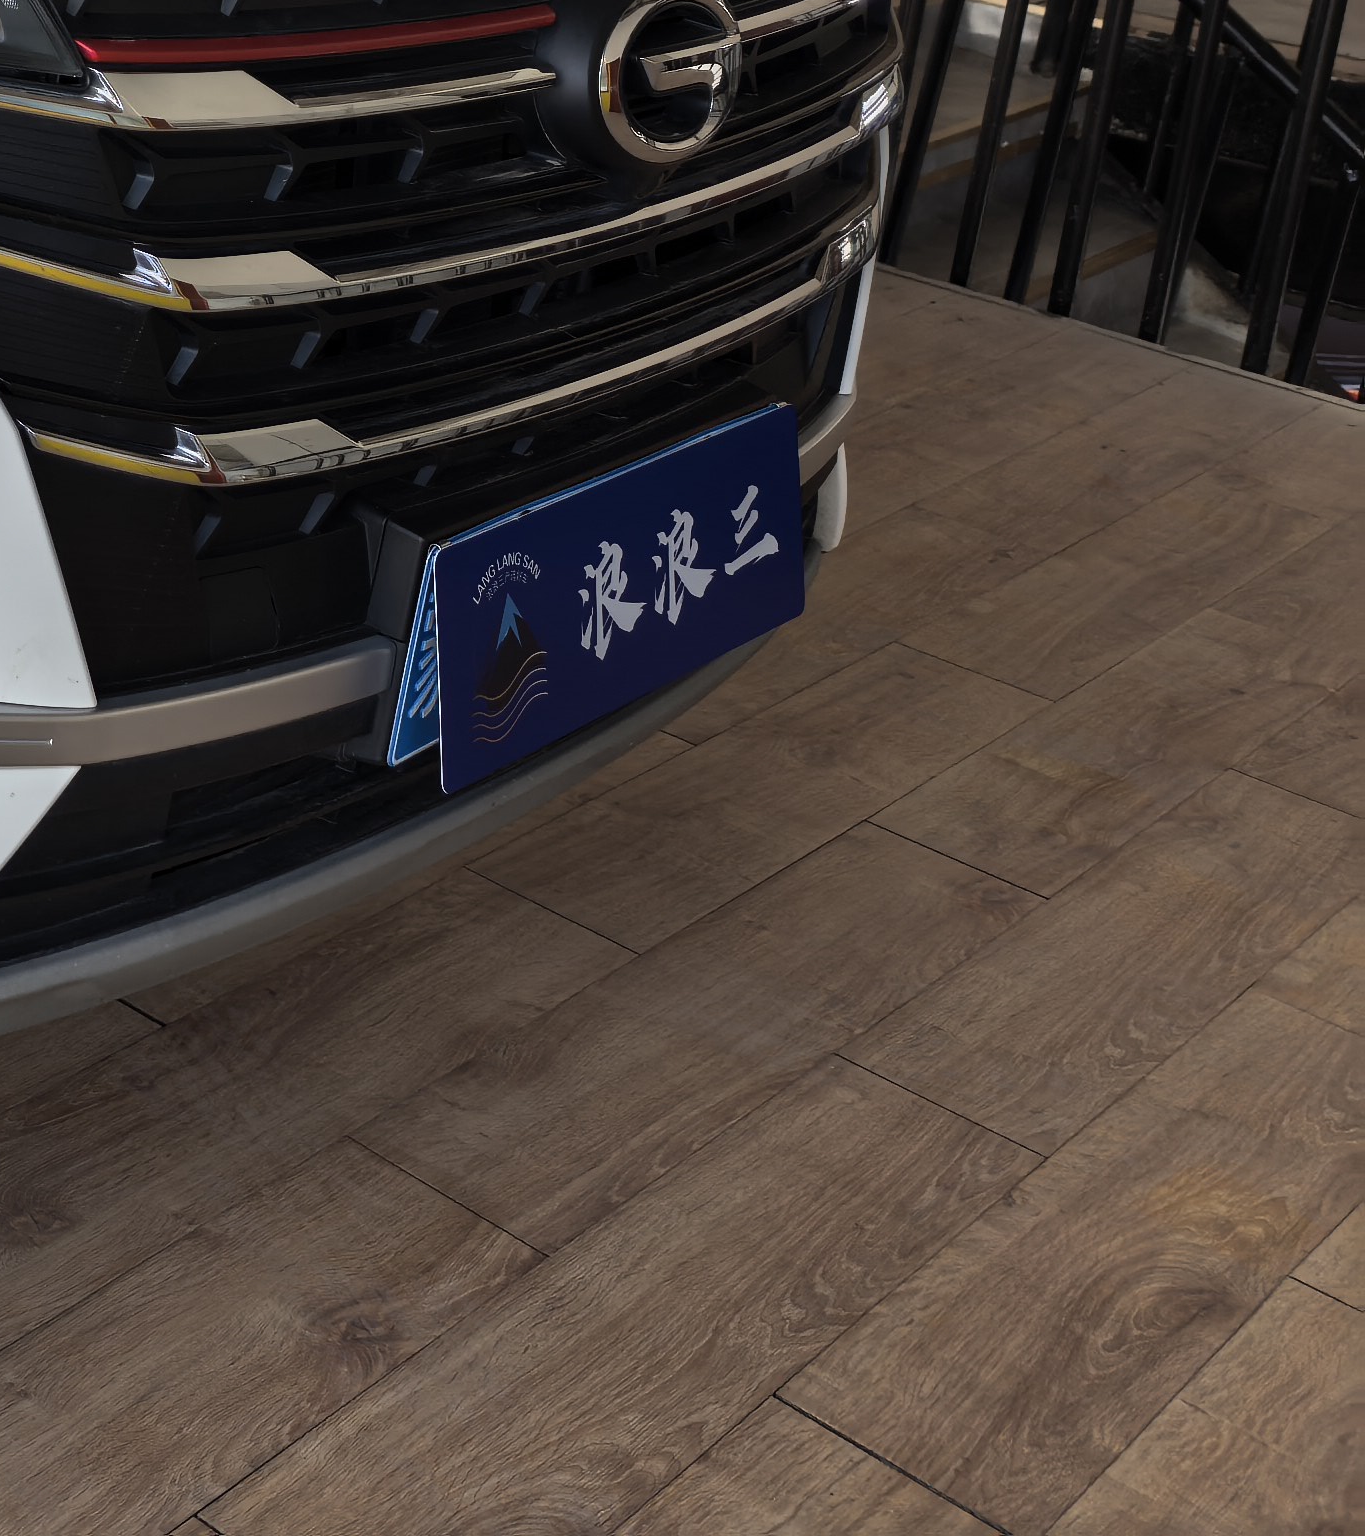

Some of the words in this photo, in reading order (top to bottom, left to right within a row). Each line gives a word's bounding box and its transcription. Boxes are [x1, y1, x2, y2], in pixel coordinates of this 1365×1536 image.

[472, 564, 496, 605] LANG
[496, 551, 522, 571] LANG
[522, 554, 541, 580] SAN
[579, 485, 779, 661] 浪浪三
